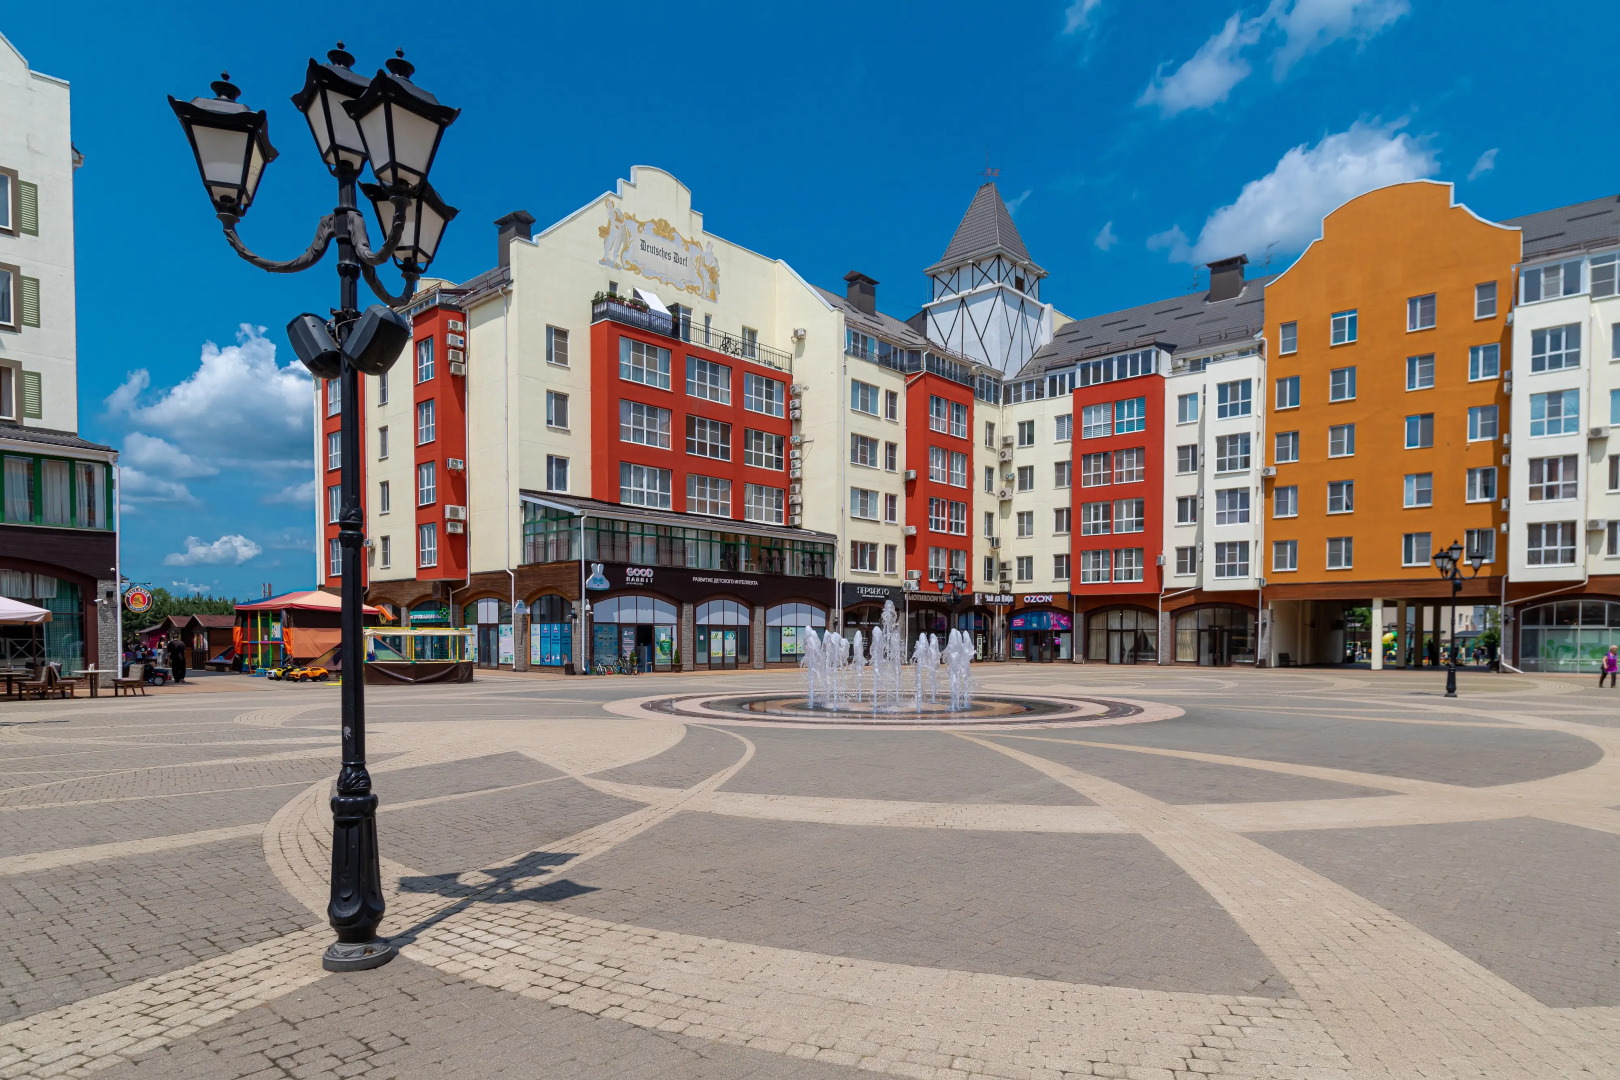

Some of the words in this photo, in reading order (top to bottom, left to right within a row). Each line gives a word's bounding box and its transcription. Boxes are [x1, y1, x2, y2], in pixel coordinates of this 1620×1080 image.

[640, 239, 672, 261] Deutsches
[673, 251, 688, 267] Dorf
[626, 567, 654, 578] GOOD
[1024, 595, 1053, 603] OZON
